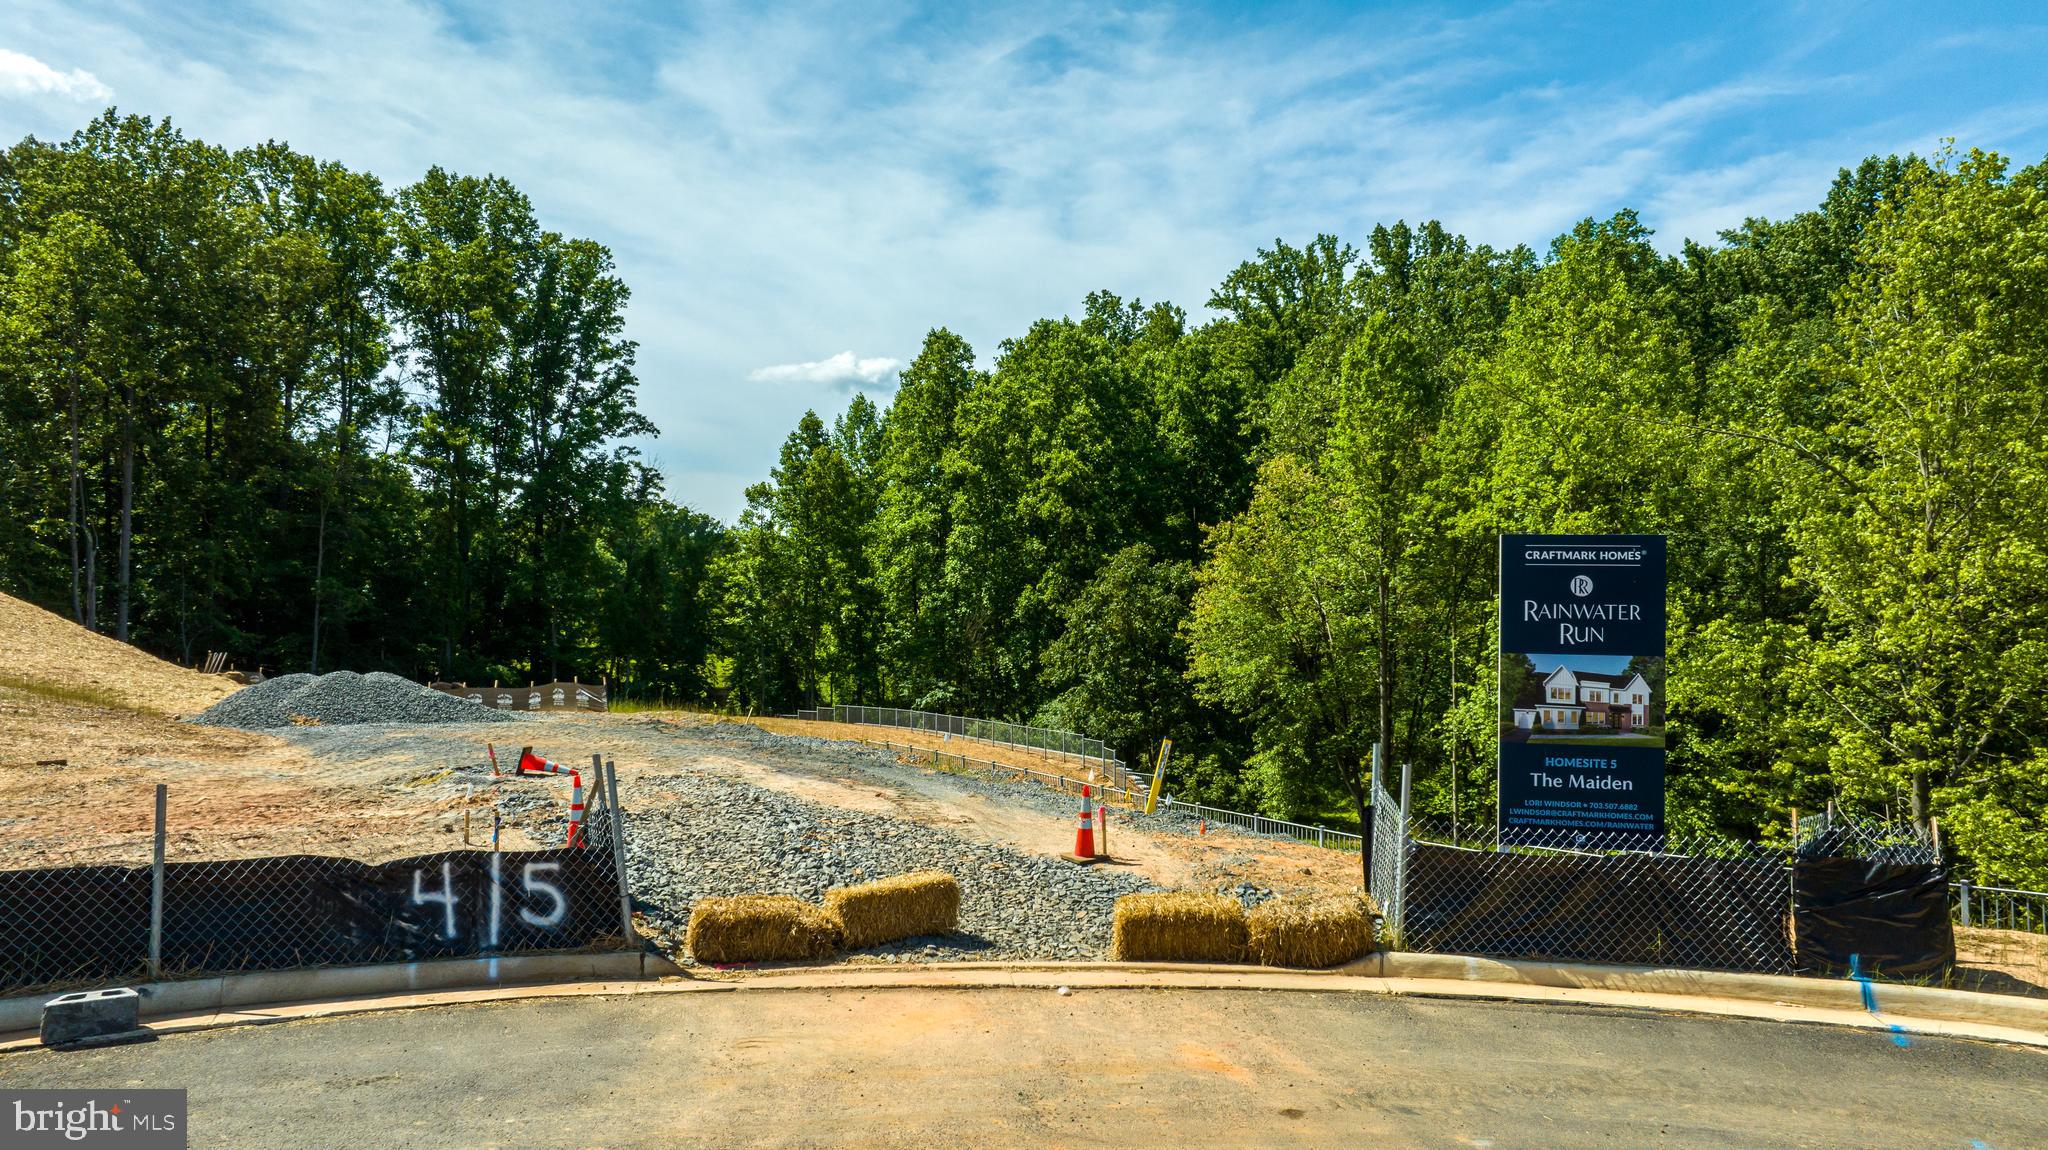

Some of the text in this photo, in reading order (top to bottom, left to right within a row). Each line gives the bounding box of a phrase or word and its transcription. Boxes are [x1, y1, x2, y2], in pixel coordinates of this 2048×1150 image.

[1525, 550, 1596, 560] CRAFTMARK
[1524, 600, 1641, 621] RAINWATER
[1560, 623, 1604, 644] RUN
[1545, 757, 1618, 769] HOMESITE 5
[1530, 772, 1633, 791] The Maiden
[1524, 799, 1639, 811] LORI WINDSOR 703.507.6882
[1509, 808, 1654, 821] LWINDSOR@CRAFTMARKHOMES.COM
[1508, 817, 1655, 831] CRAFTMARKHOMES.COM/RAINWATER
